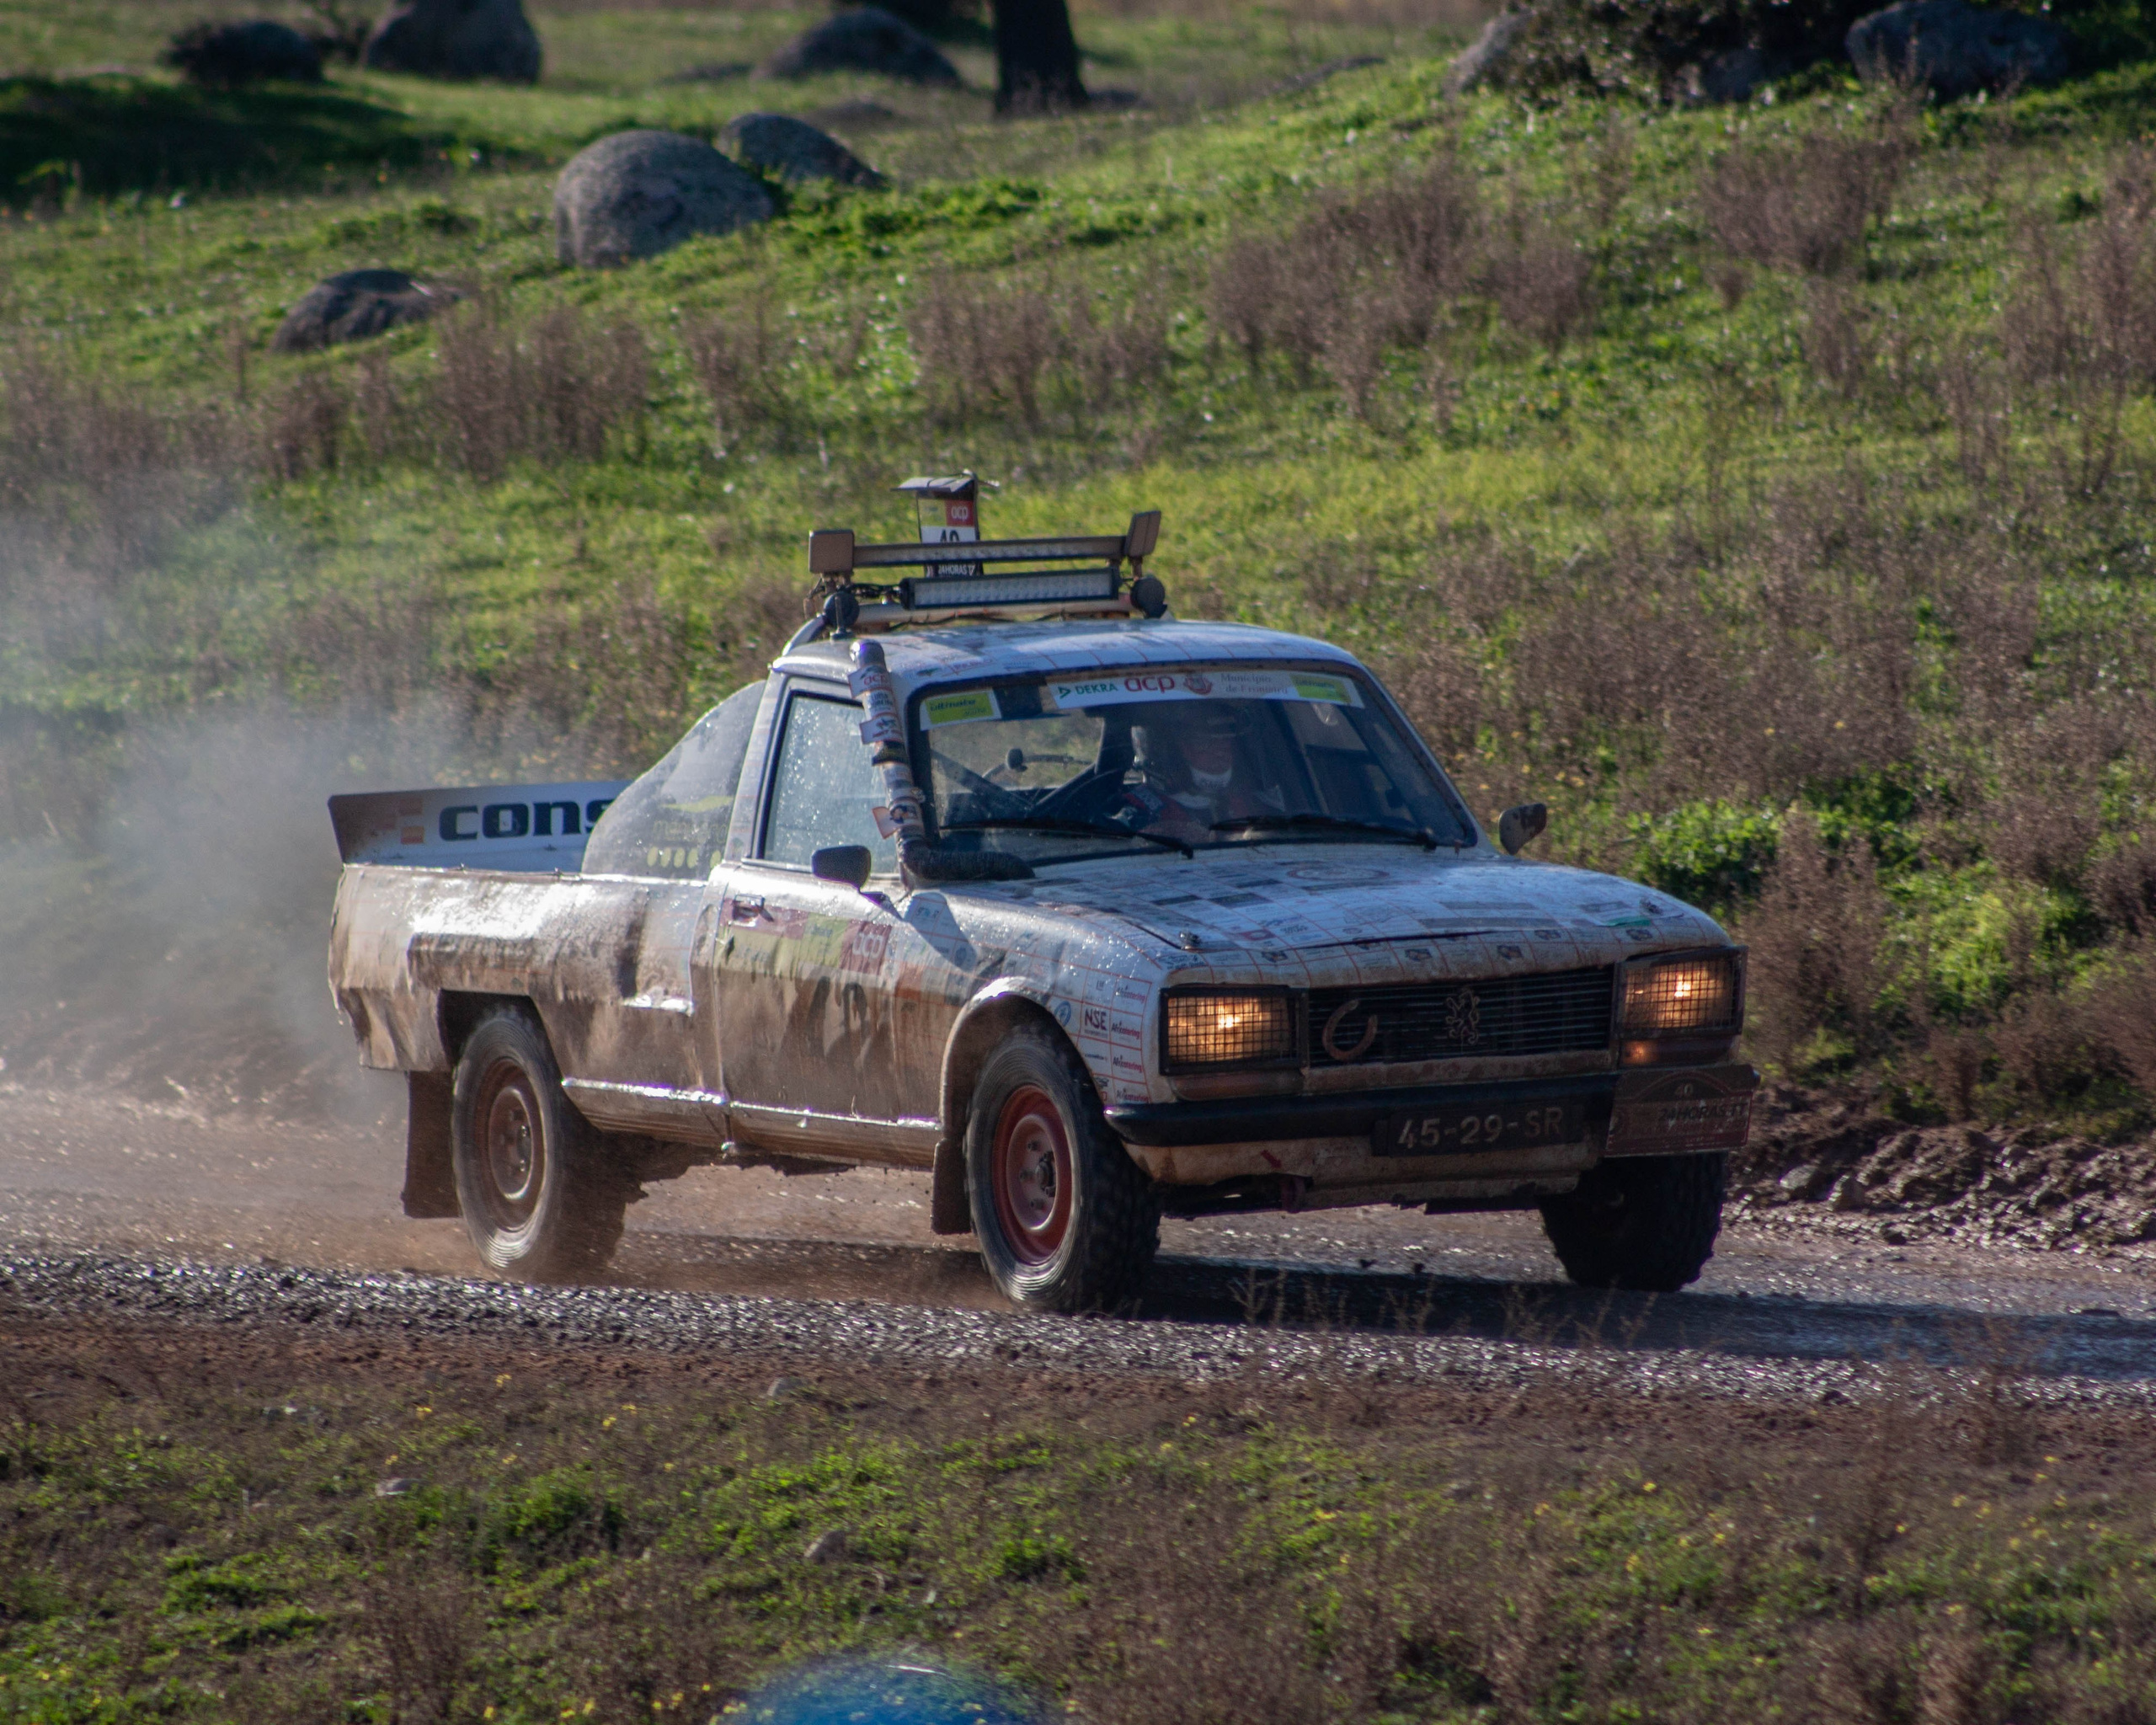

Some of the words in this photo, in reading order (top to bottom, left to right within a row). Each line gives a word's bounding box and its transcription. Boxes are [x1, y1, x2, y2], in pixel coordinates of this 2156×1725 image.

[1075, 682, 1118, 695] DEKRA
[1084, 1008, 1107, 1031] NSE
[1396, 1106, 1564, 1149] 45-29-SR
